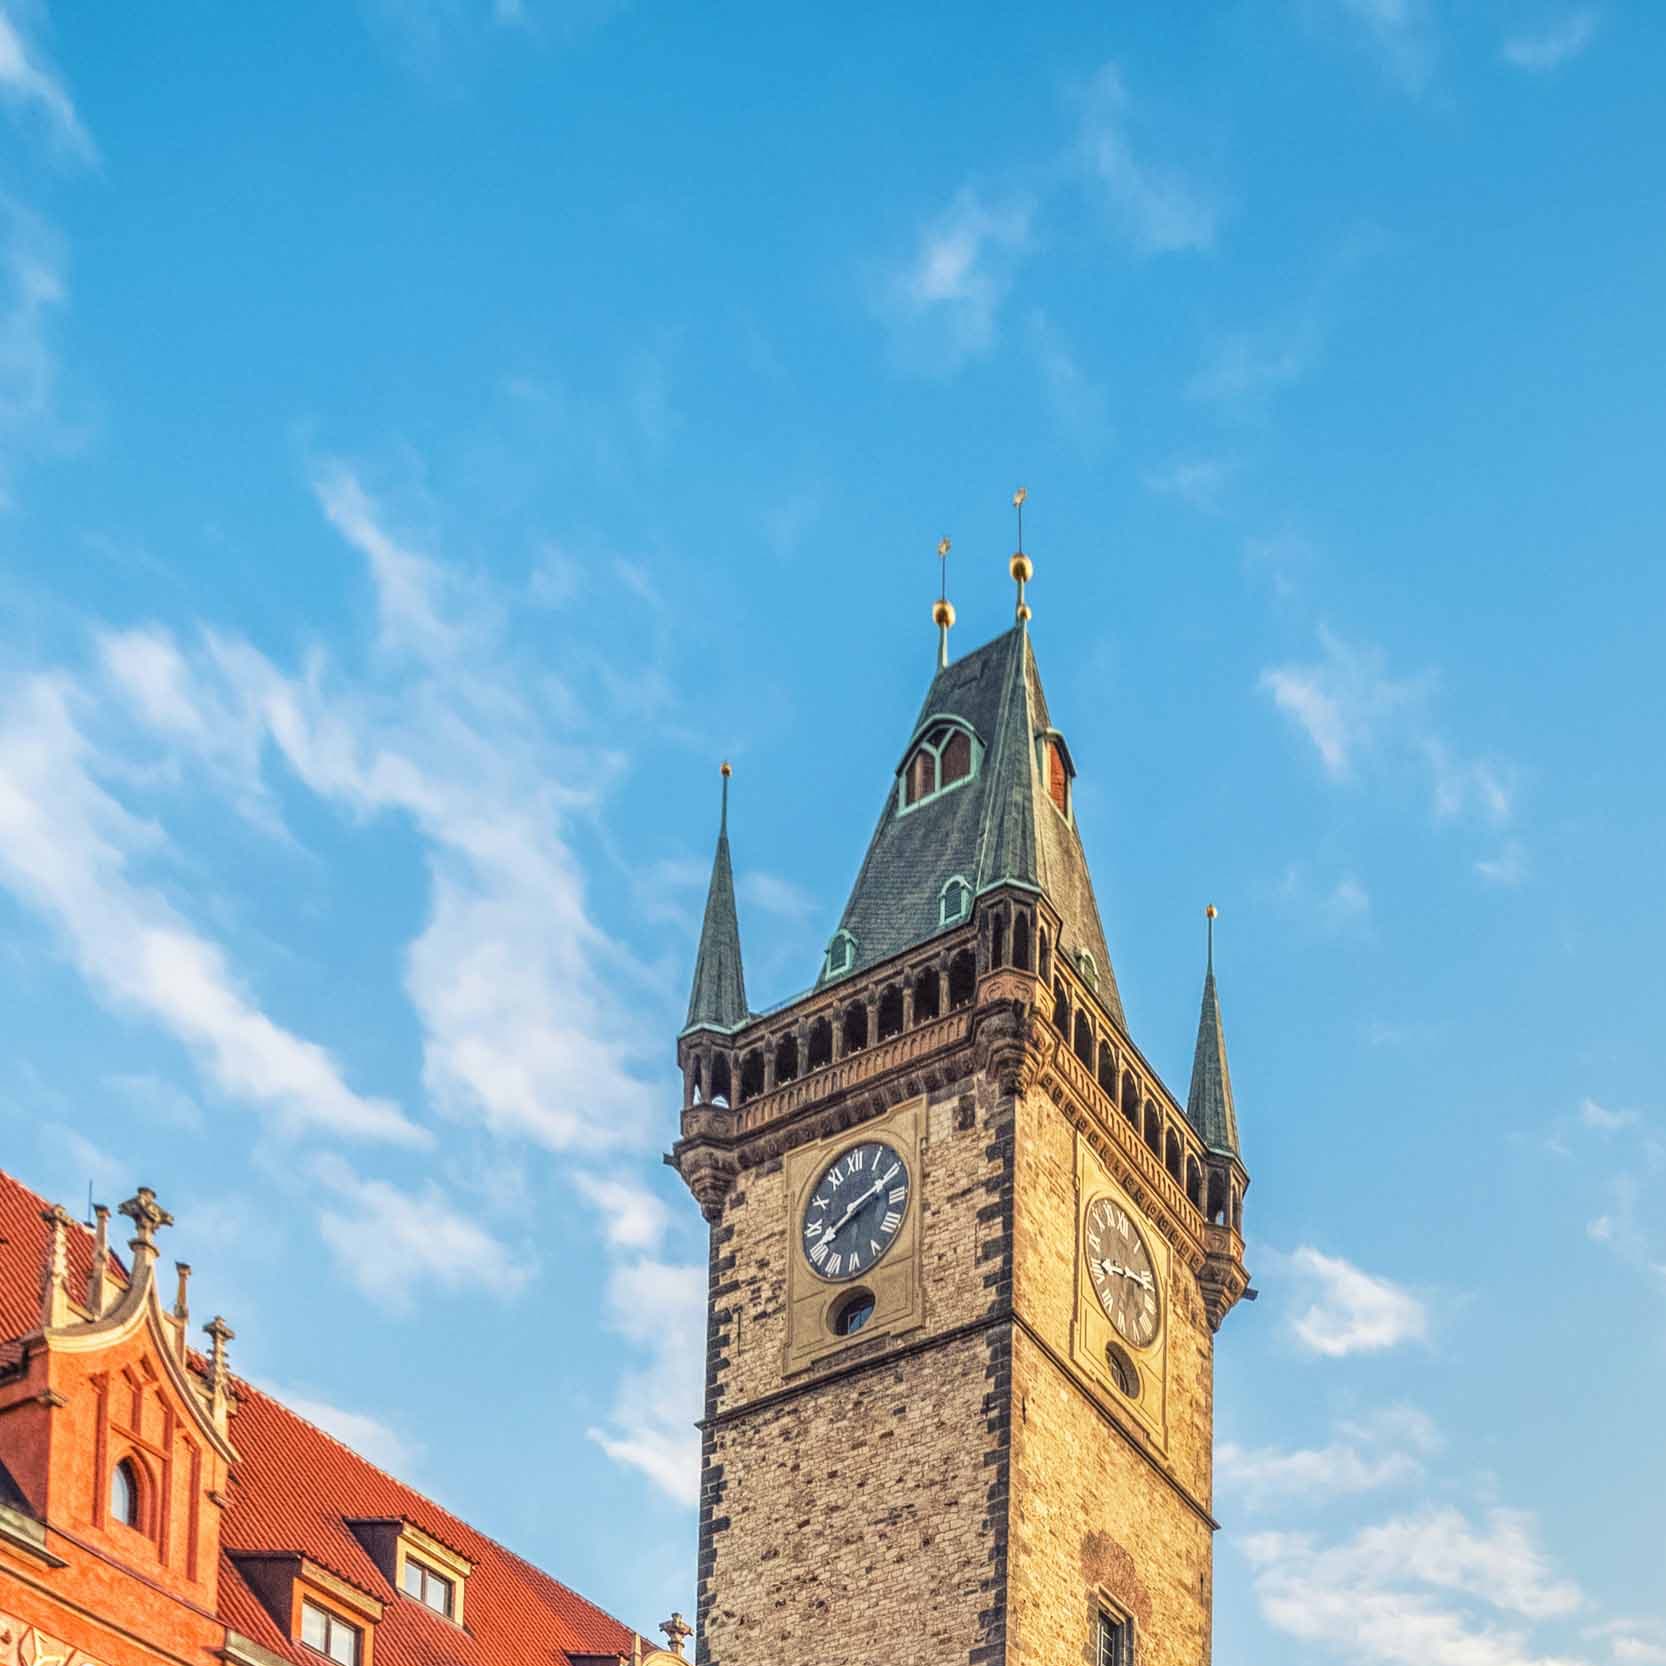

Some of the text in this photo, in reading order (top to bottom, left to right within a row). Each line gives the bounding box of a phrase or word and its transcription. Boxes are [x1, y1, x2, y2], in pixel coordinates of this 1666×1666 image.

[847, 1151, 863, 1175] XII
[828, 1167, 844, 1191] XI
[812, 1194, 830, 1210] X
[888, 1186, 906, 1205] III
